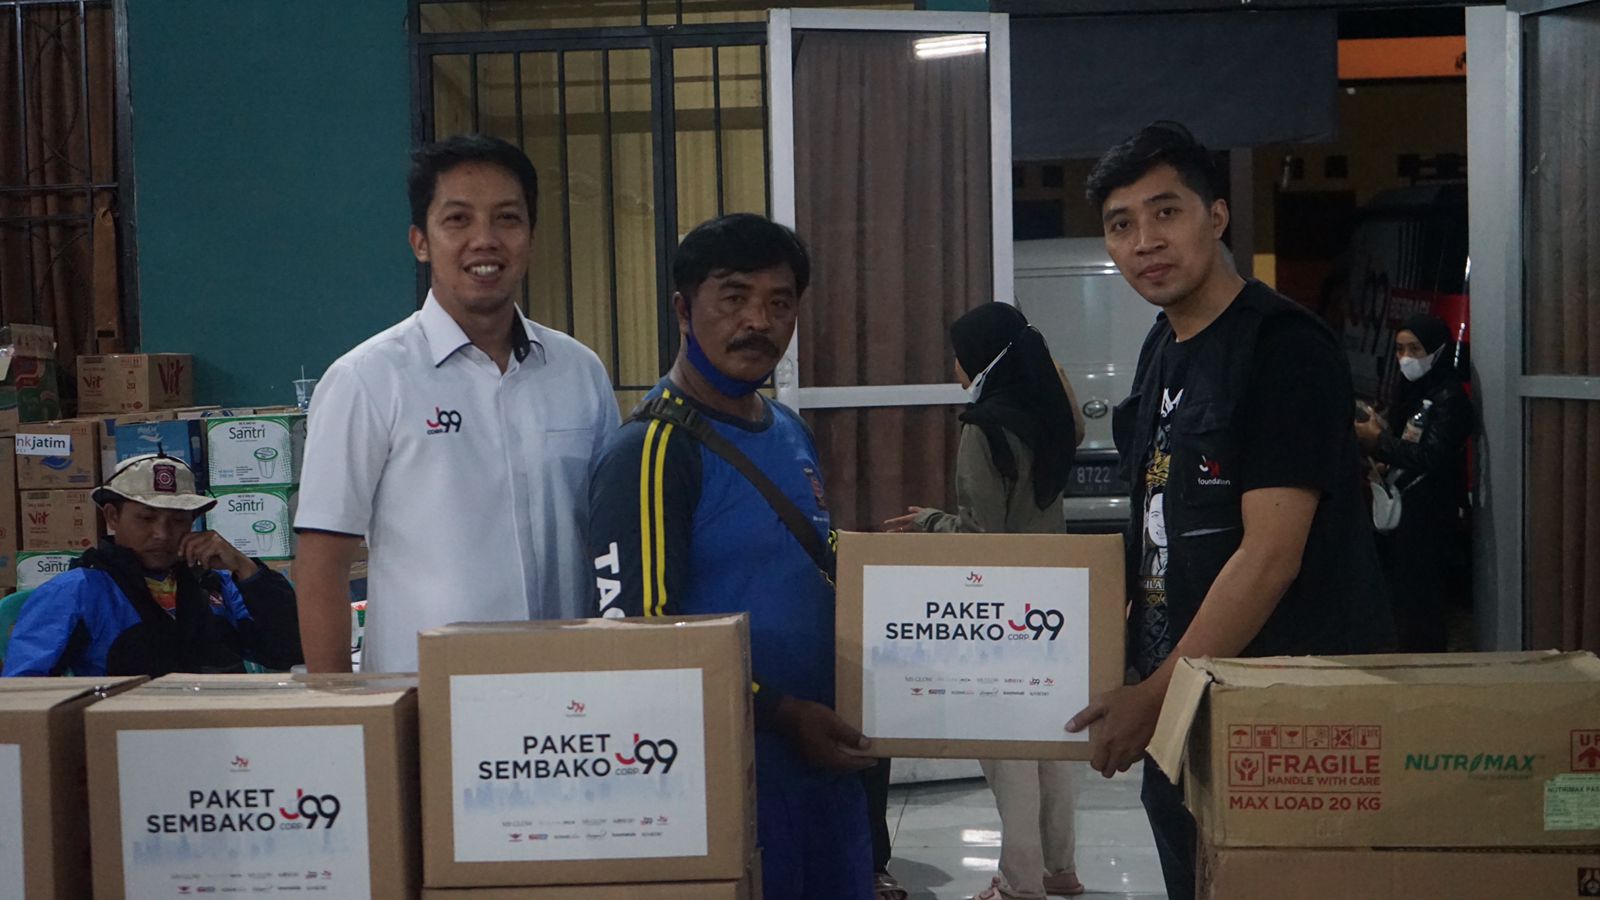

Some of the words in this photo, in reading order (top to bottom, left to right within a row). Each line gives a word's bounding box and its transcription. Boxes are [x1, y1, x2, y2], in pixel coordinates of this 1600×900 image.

[83, 375, 103, 388] Vit
[158, 358, 184, 396] Vit
[426, 406, 462, 433] J99
[229, 424, 265, 440] Santri
[1077, 466, 1111, 483] 8722
[228, 498, 264, 512] Santri
[28, 511, 50, 525] Vit
[37, 560, 69, 573] Santr
[594, 541, 626, 618] TA
[926, 602, 1005, 619] PAKET
[885, 622, 1005, 641] SEMBAKO
[1008, 603, 1065, 641] J99
[523, 733, 611, 754] PAKET
[615, 733, 678, 775] J99
[1267, 754, 1381, 774] FRAGILE
[478, 758, 611, 780] SEMBAKO
[1267, 776, 1314, 785] HANDLE
[1317, 776, 1346, 786] WITH
[1349, 777, 1381, 786] CARE
[190, 789, 275, 809] PAKET
[279, 788, 341, 830] J99
[1229, 796, 1269, 810] MAX
[1274, 796, 1324, 810] LOAD
[1329, 797, 1352, 810] 20
[1357, 797, 1381, 811] KG
[147, 812, 275, 833] SEMBAKO
